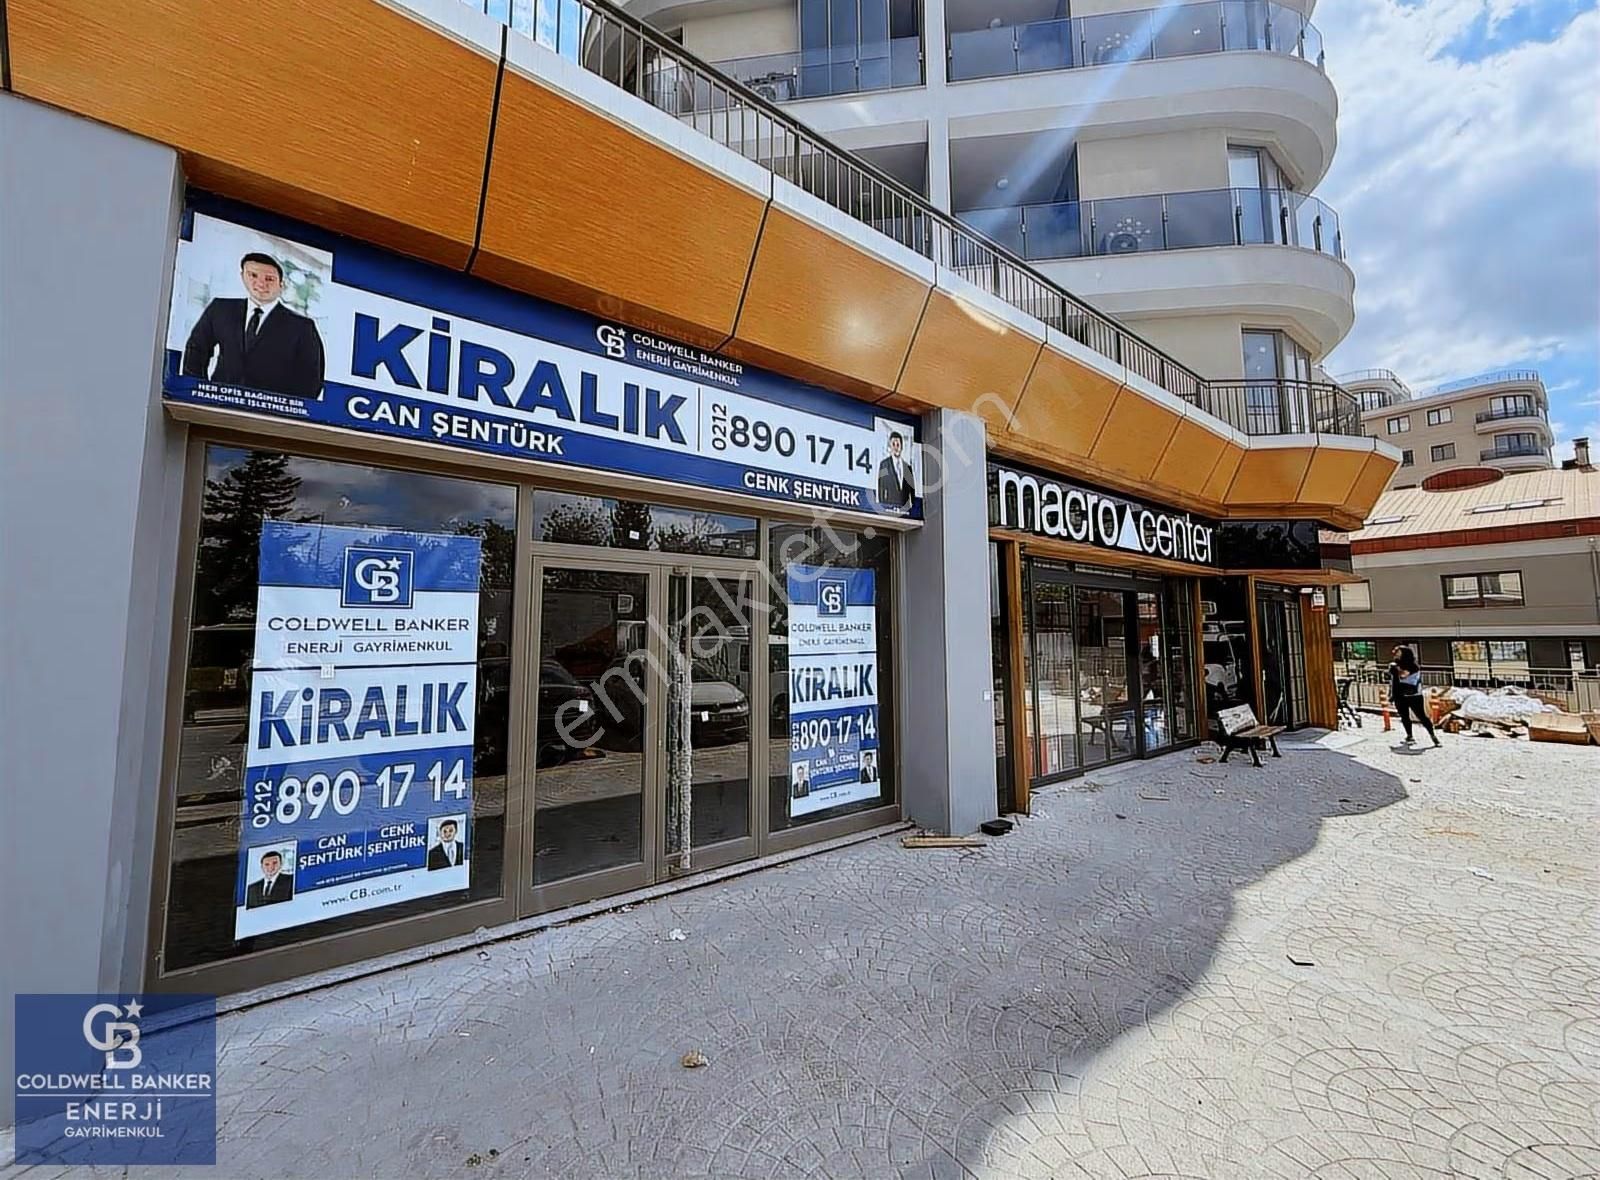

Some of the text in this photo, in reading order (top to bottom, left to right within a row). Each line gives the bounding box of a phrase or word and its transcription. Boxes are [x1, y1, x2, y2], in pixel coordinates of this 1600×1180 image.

[632, 333, 743, 374] COLDWELL BANKER
[635, 349, 740, 386] ENERJİ GAYRİMENKUL
[198, 383, 218, 393] HER
[220, 386, 242, 397] OFİS
[351, 311, 688, 446] KİRALIK
[347, 396, 564, 455] CAN ŞENTÜRK
[712, 403, 728, 450] 0212
[729, 415, 873, 474] 890 17 14
[743, 471, 860, 507] CENK ŞENTÜRK
[998, 469, 1213, 563] macro center
[268, 617, 470, 632] COLDWELL BANKER
[791, 623, 872, 633] COLDWELL BANKER
[287, 640, 453, 654] ENERJİ GAYRİMENKUL
[791, 664, 874, 703] KİRALIK
[258, 681, 469, 750] KİRALIK
[800, 707, 876, 751] 890 17 14
[252, 780, 273, 829] 0212
[275, 759, 467, 825] 890 17 14
[318, 834, 347, 849] CAN
[367, 835, 426, 857] ŞENTÜRK
[380, 823, 414, 838] CENK
[299, 845, 363, 871] ŞENTÜRK
[321, 884, 403, 907] www.CB.com.tr
